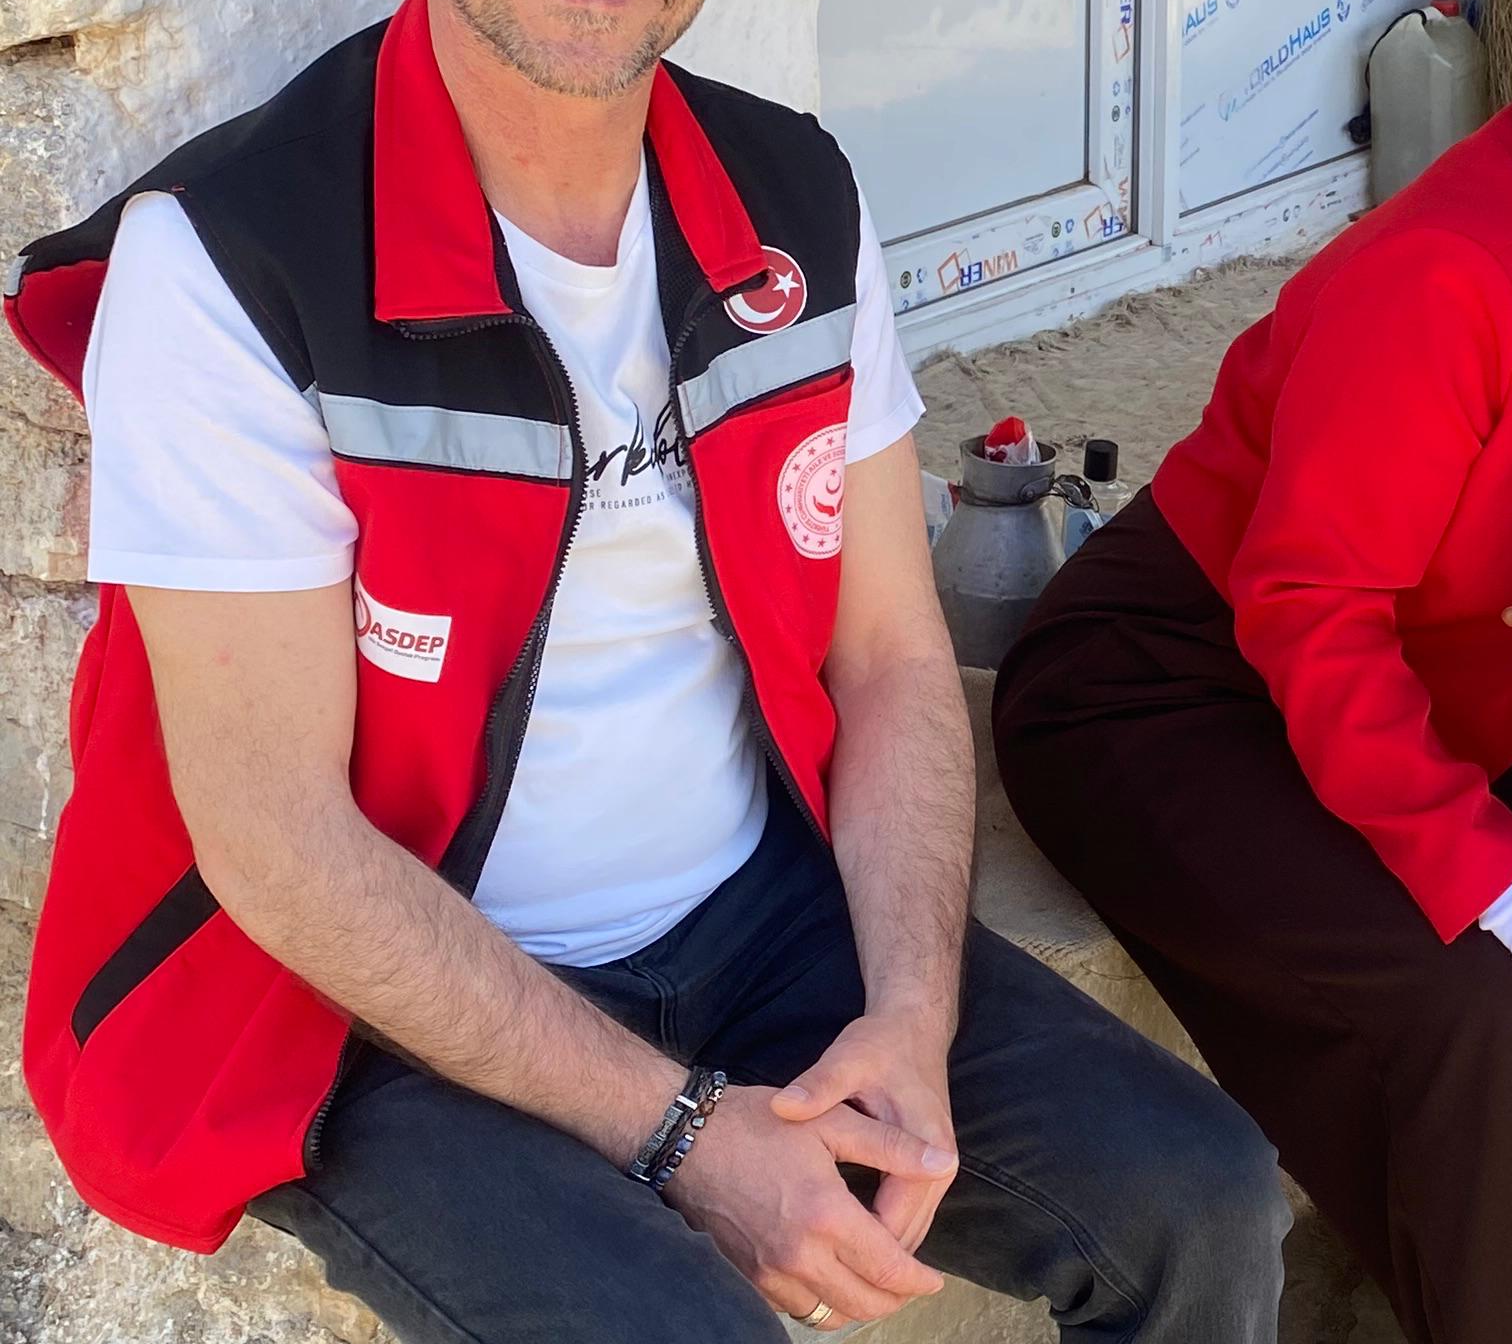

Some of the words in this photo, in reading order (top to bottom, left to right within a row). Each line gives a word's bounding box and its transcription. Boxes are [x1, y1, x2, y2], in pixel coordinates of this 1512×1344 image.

[959, 250, 1018, 287] WINER
[601, 495, 652, 510] REGARDED
[370, 621, 444, 654] ASDEP
